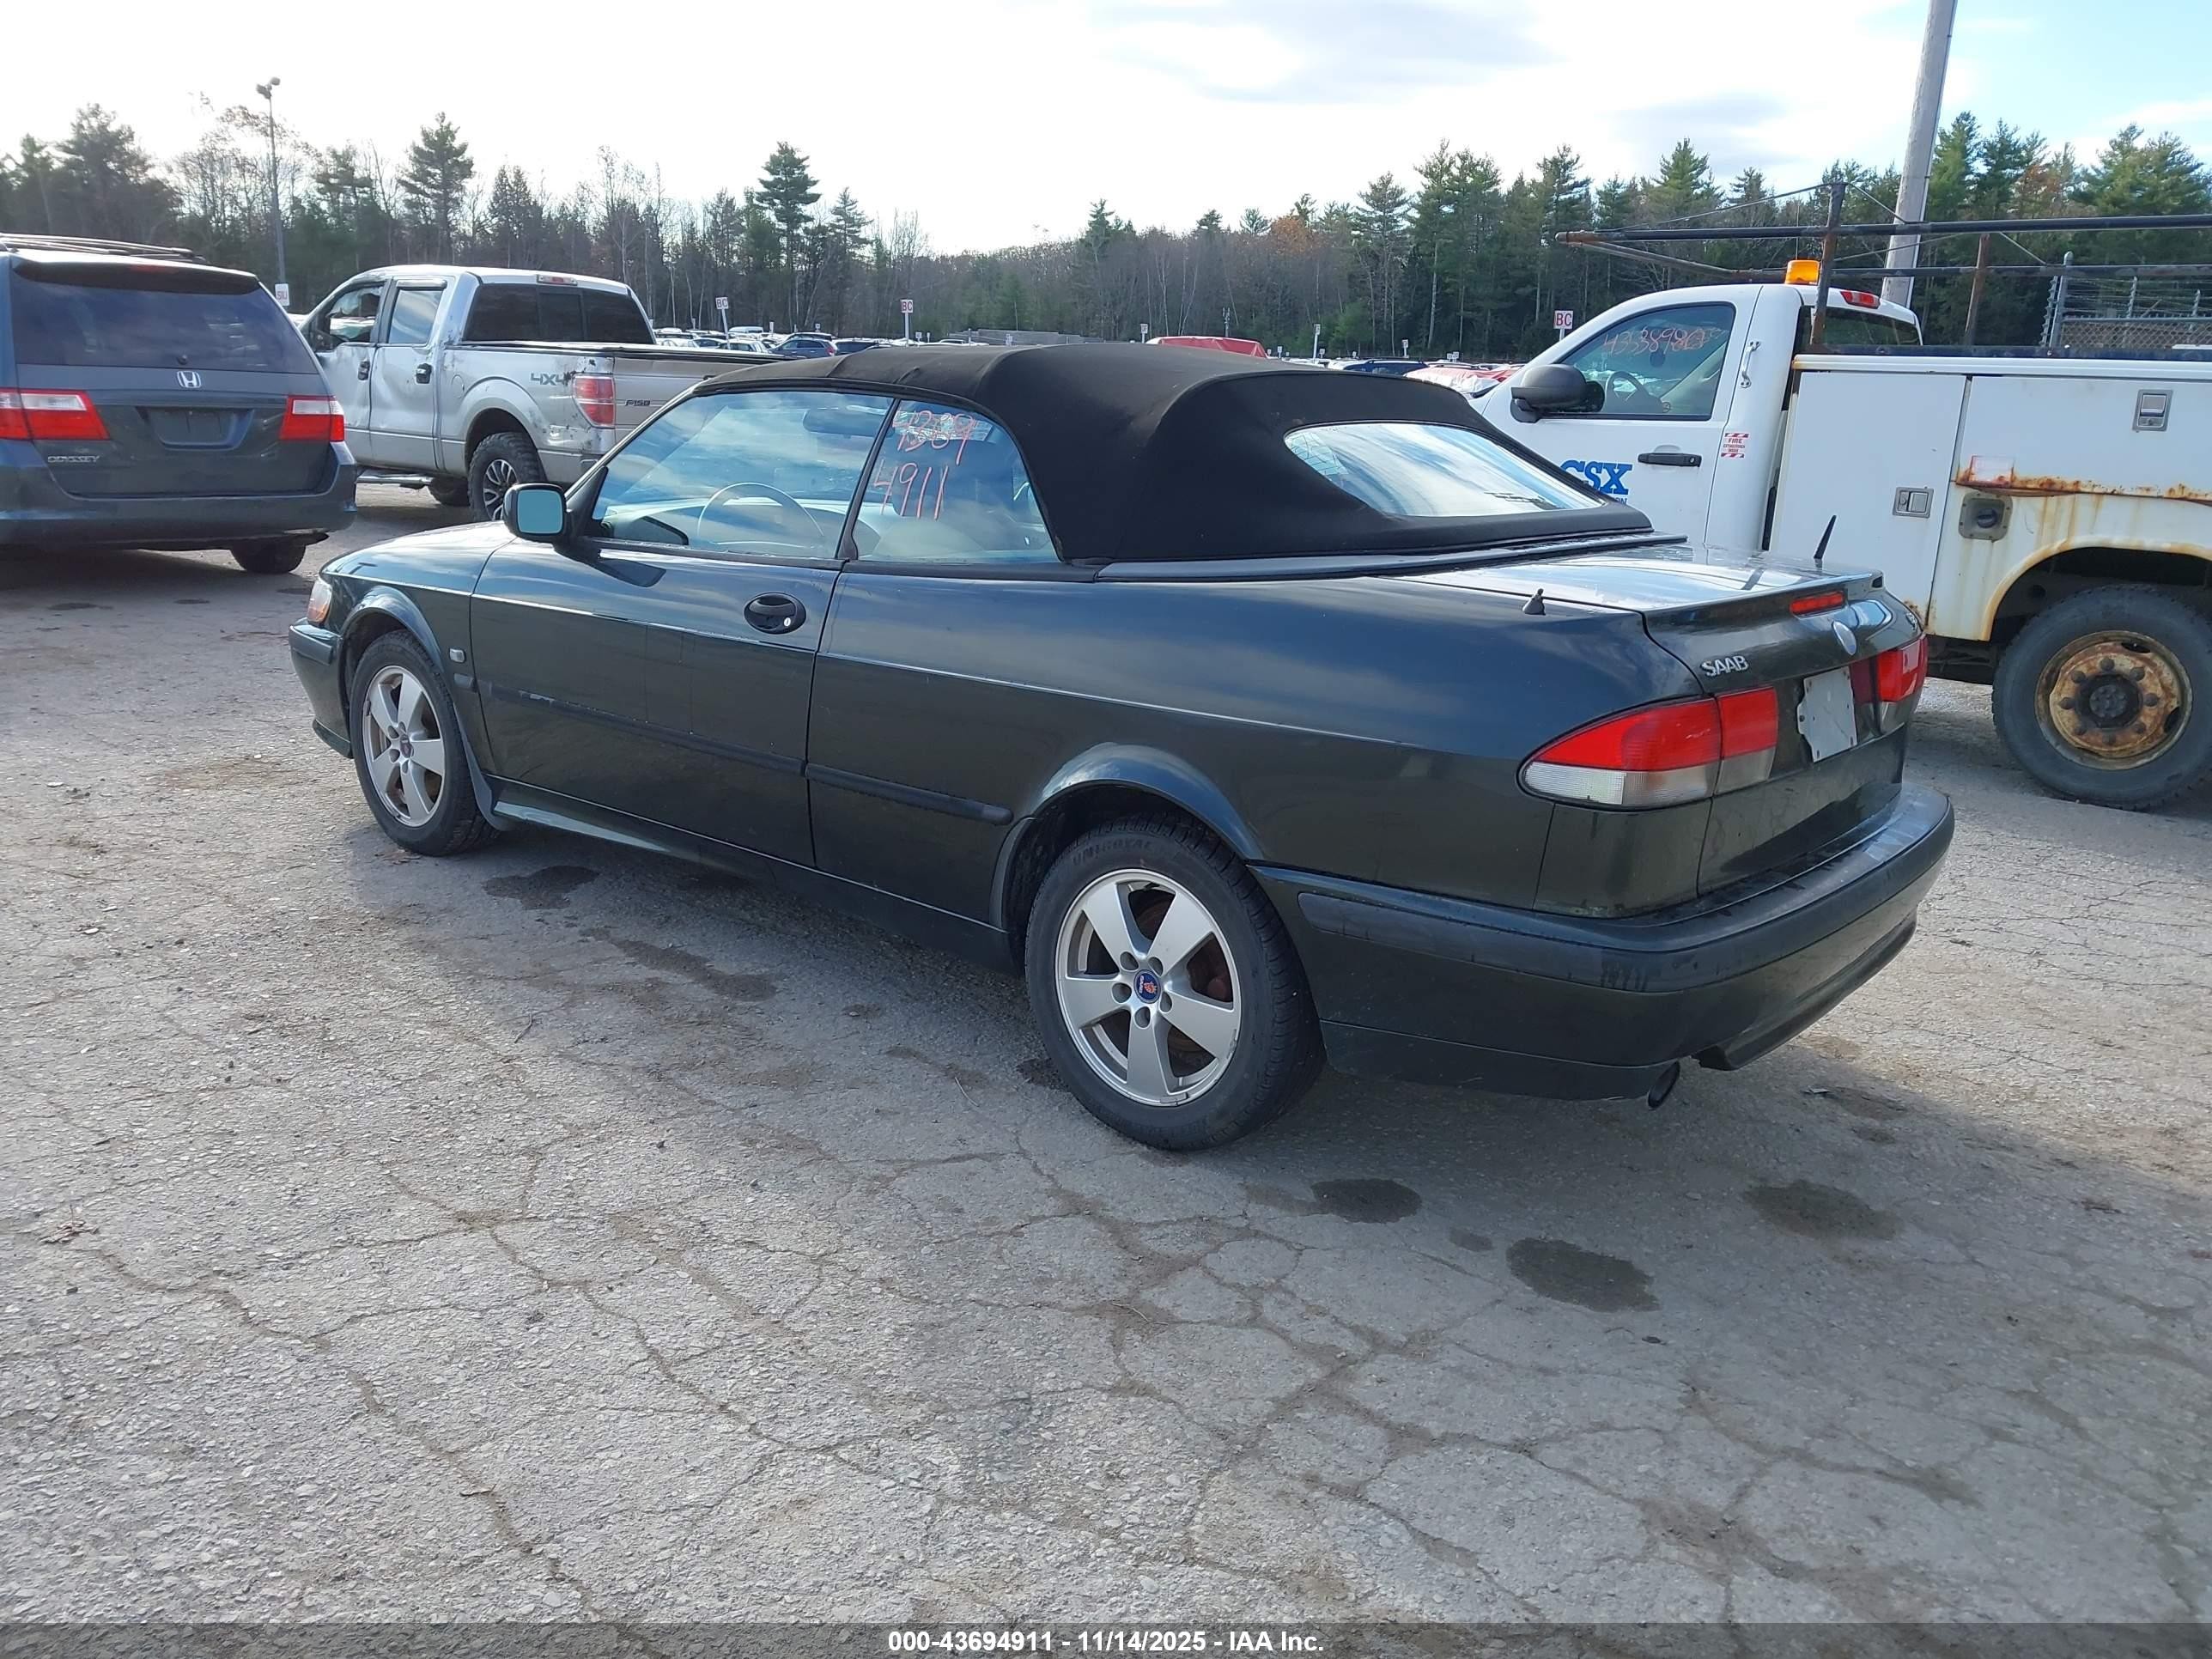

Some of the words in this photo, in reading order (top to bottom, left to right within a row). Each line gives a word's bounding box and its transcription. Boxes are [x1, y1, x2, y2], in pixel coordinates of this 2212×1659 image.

[716, 299, 728, 307] BC
[902, 301, 913, 312] BC
[1556, 313, 1572, 326] BC
[874, 457, 949, 520] 4911
[1701, 655, 1749, 677] SAAB
